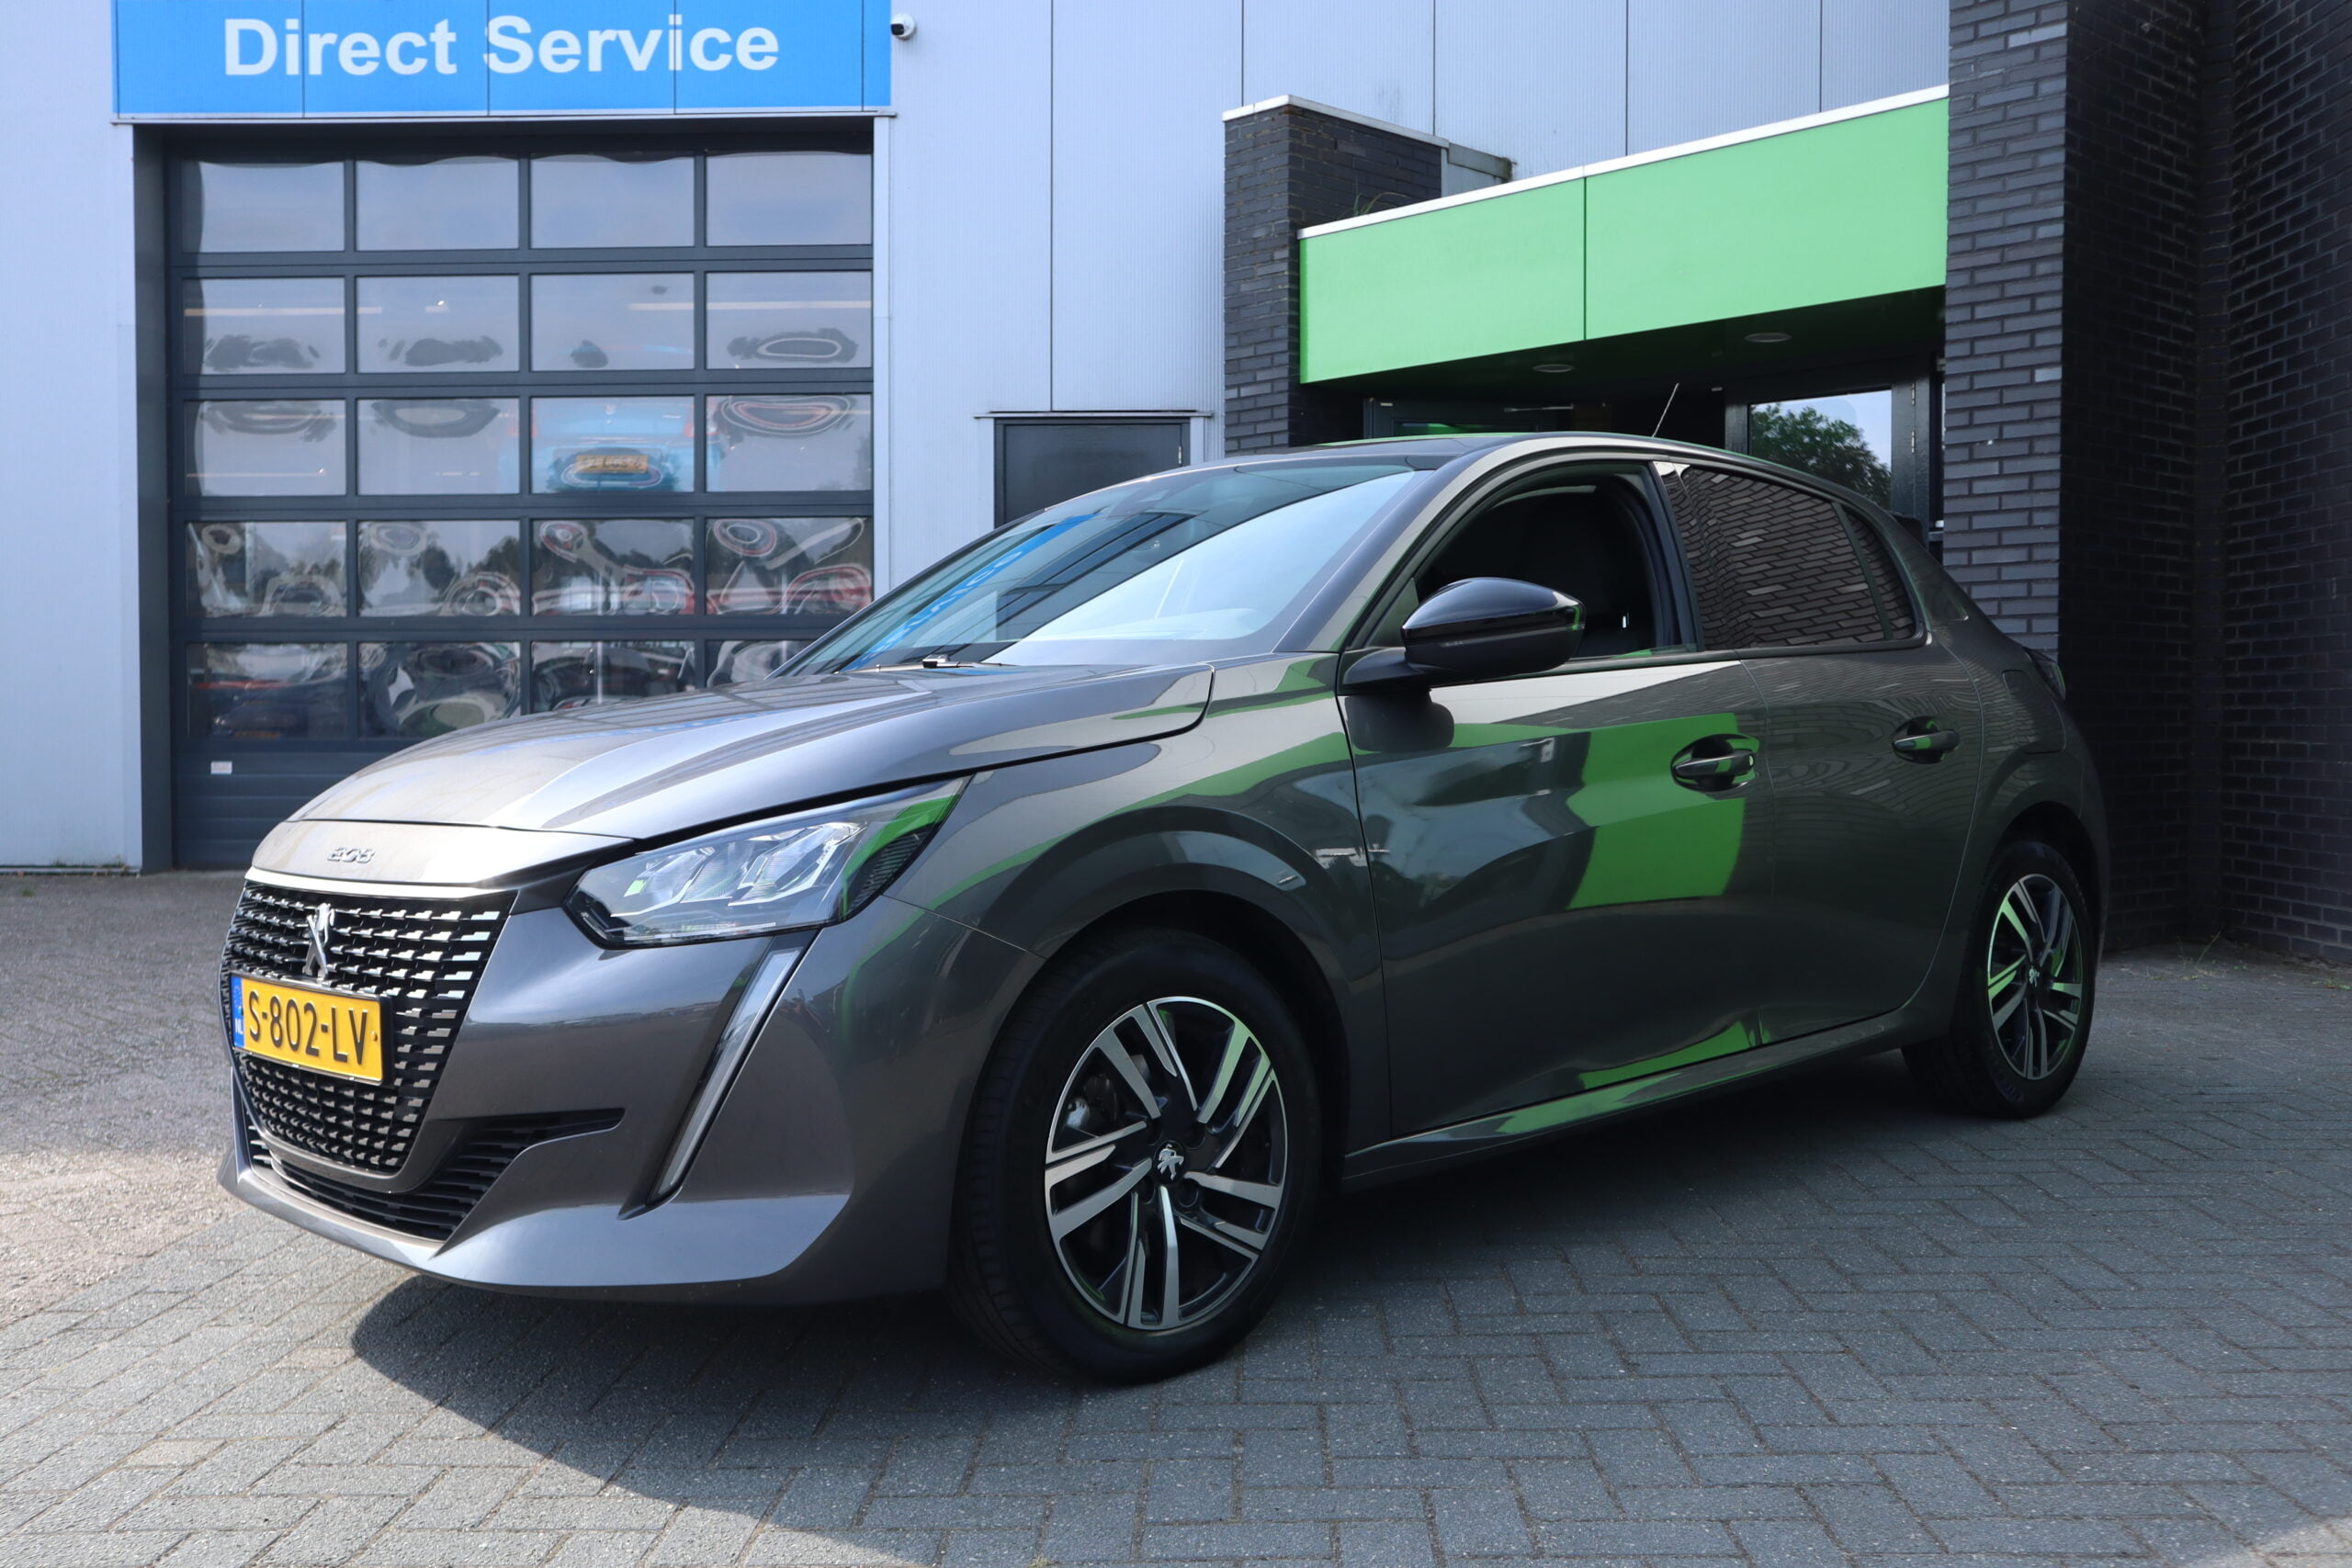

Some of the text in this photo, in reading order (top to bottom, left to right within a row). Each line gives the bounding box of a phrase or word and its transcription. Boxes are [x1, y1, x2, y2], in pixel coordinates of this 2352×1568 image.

[223, 15, 779, 76] Direct Service
[326, 847, 377, 864] 208
[248, 990, 369, 1066] S-802-LV
